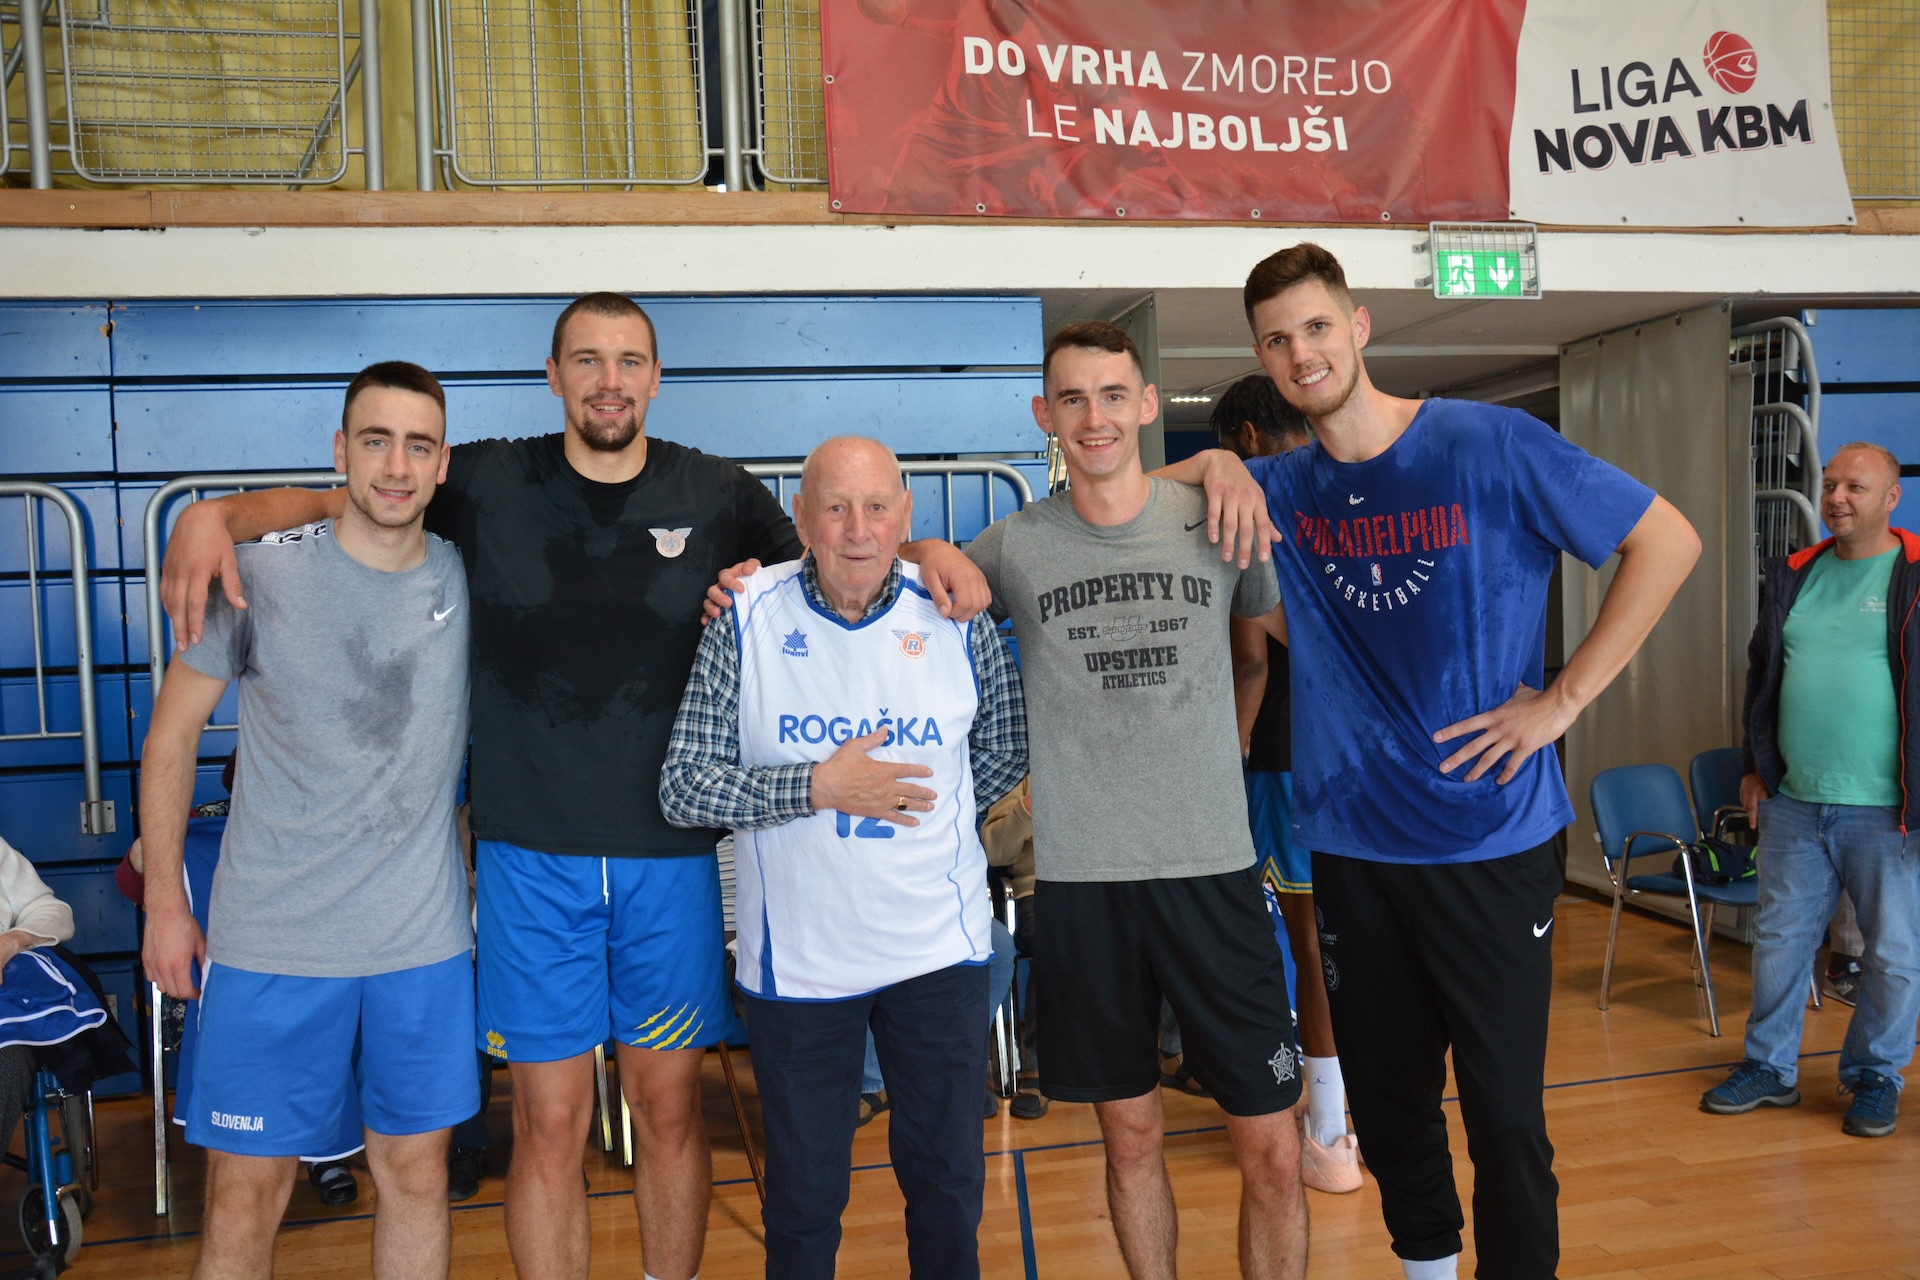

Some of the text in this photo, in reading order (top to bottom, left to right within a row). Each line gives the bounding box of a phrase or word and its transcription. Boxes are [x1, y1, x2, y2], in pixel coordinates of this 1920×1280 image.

[963, 36, 1392, 96] DO VRHA ZMOREJO
[1571, 57, 1703, 114] LIGA
[1025, 99, 1348, 151] LE NAJBOLJŠI
[1534, 99, 1814, 175] NOVA KBM
[1037, 572, 1212, 624] PROPERTY OF
[1324, 558, 1435, 612] BASKETBALL
[1067, 626, 1100, 640] EST.
[1149, 617, 1189, 633] 1967
[1084, 645, 1178, 673] UPSTATE
[1102, 671, 1167, 690] ATHLETICS
[779, 708, 943, 747] ROGAŠKA
[211, 1110, 264, 1132] SLOVENIJA
